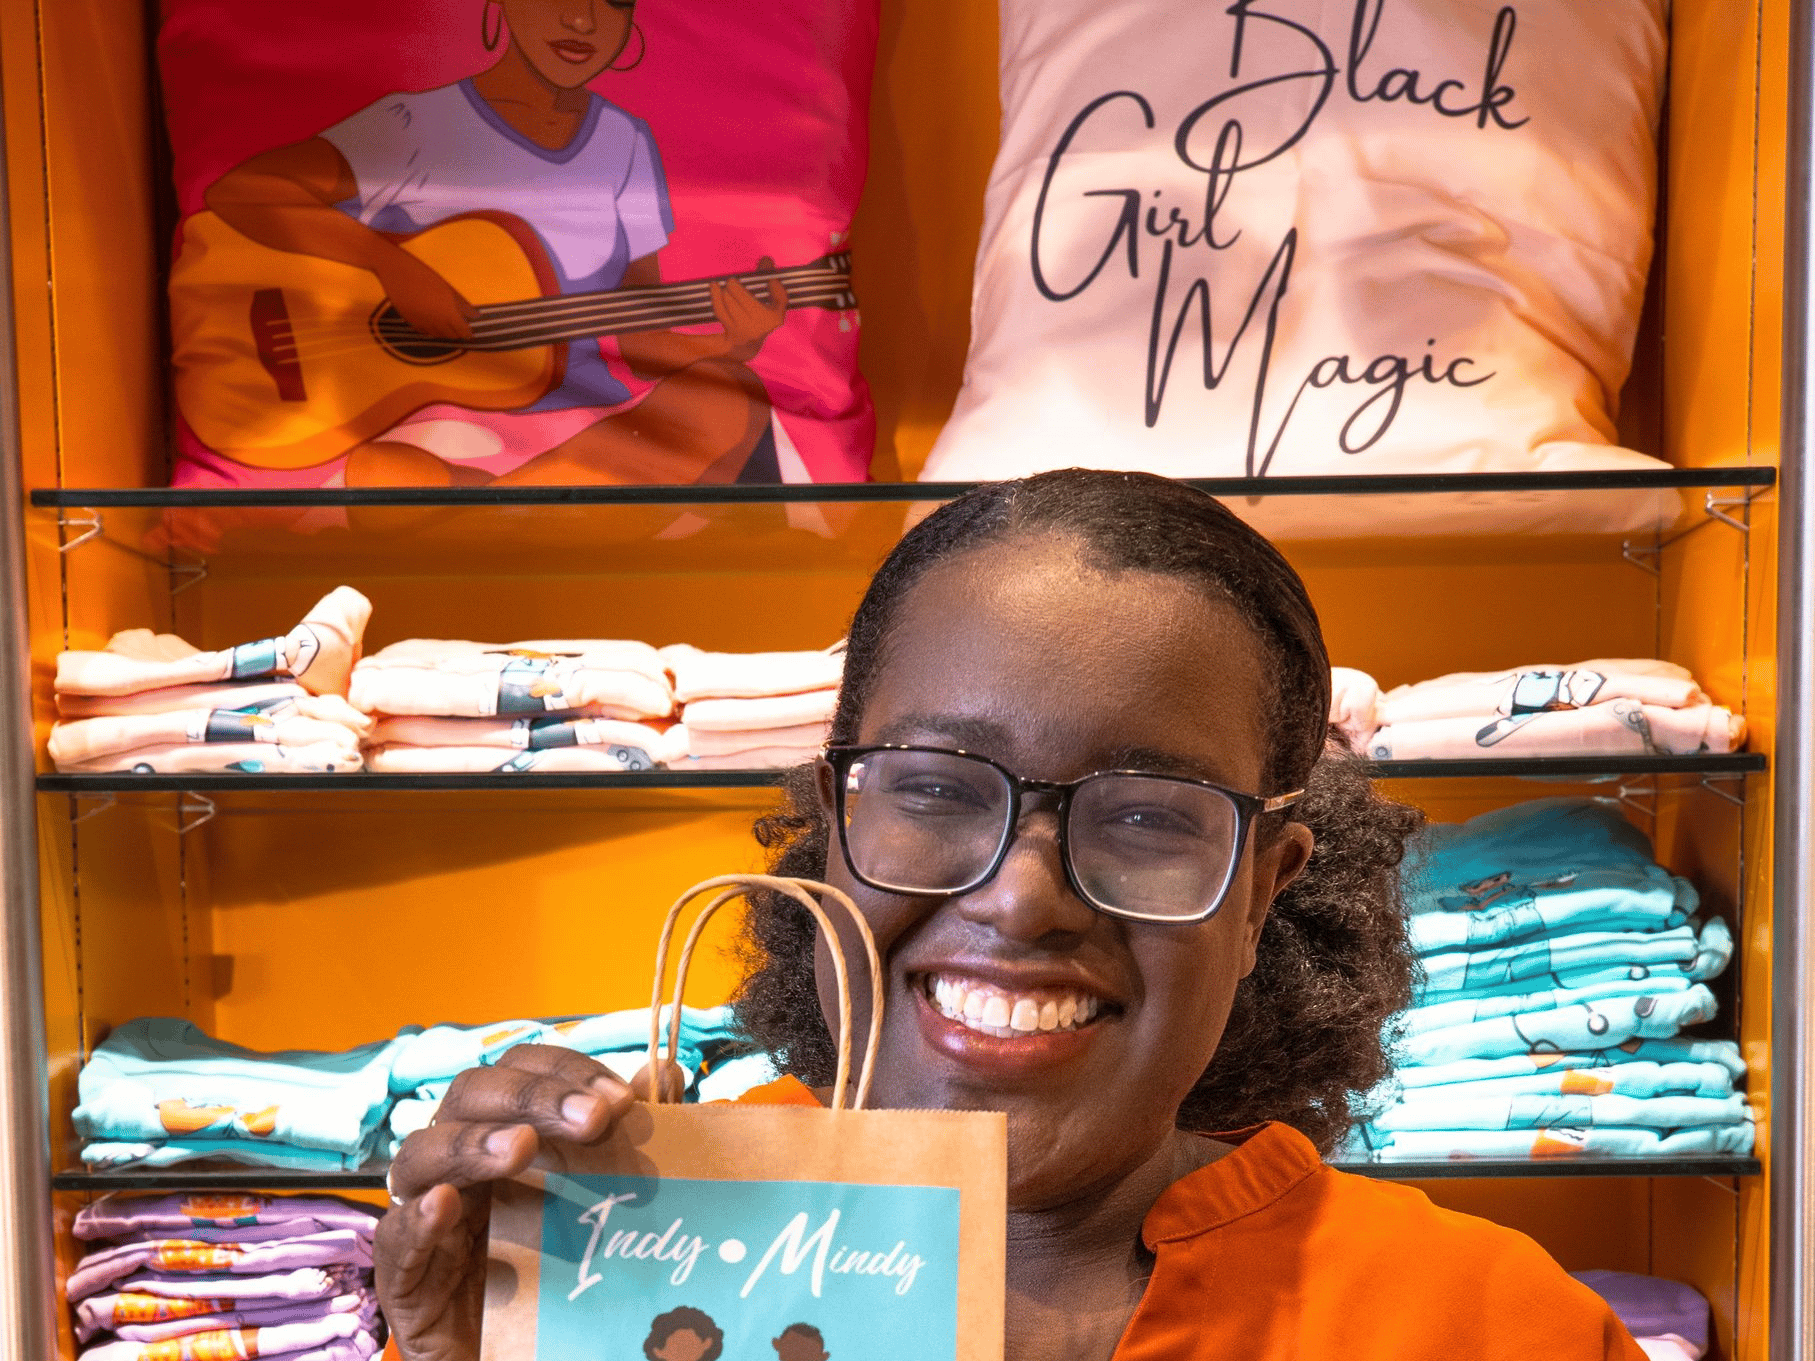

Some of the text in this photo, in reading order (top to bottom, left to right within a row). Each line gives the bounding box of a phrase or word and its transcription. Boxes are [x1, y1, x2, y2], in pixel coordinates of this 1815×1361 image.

[1175, 0, 1530, 173] Black
[1031, 91, 1242, 302] Girl
[1145, 227, 1496, 476] Magic
[568, 1193, 926, 1300] Indy Mindy
